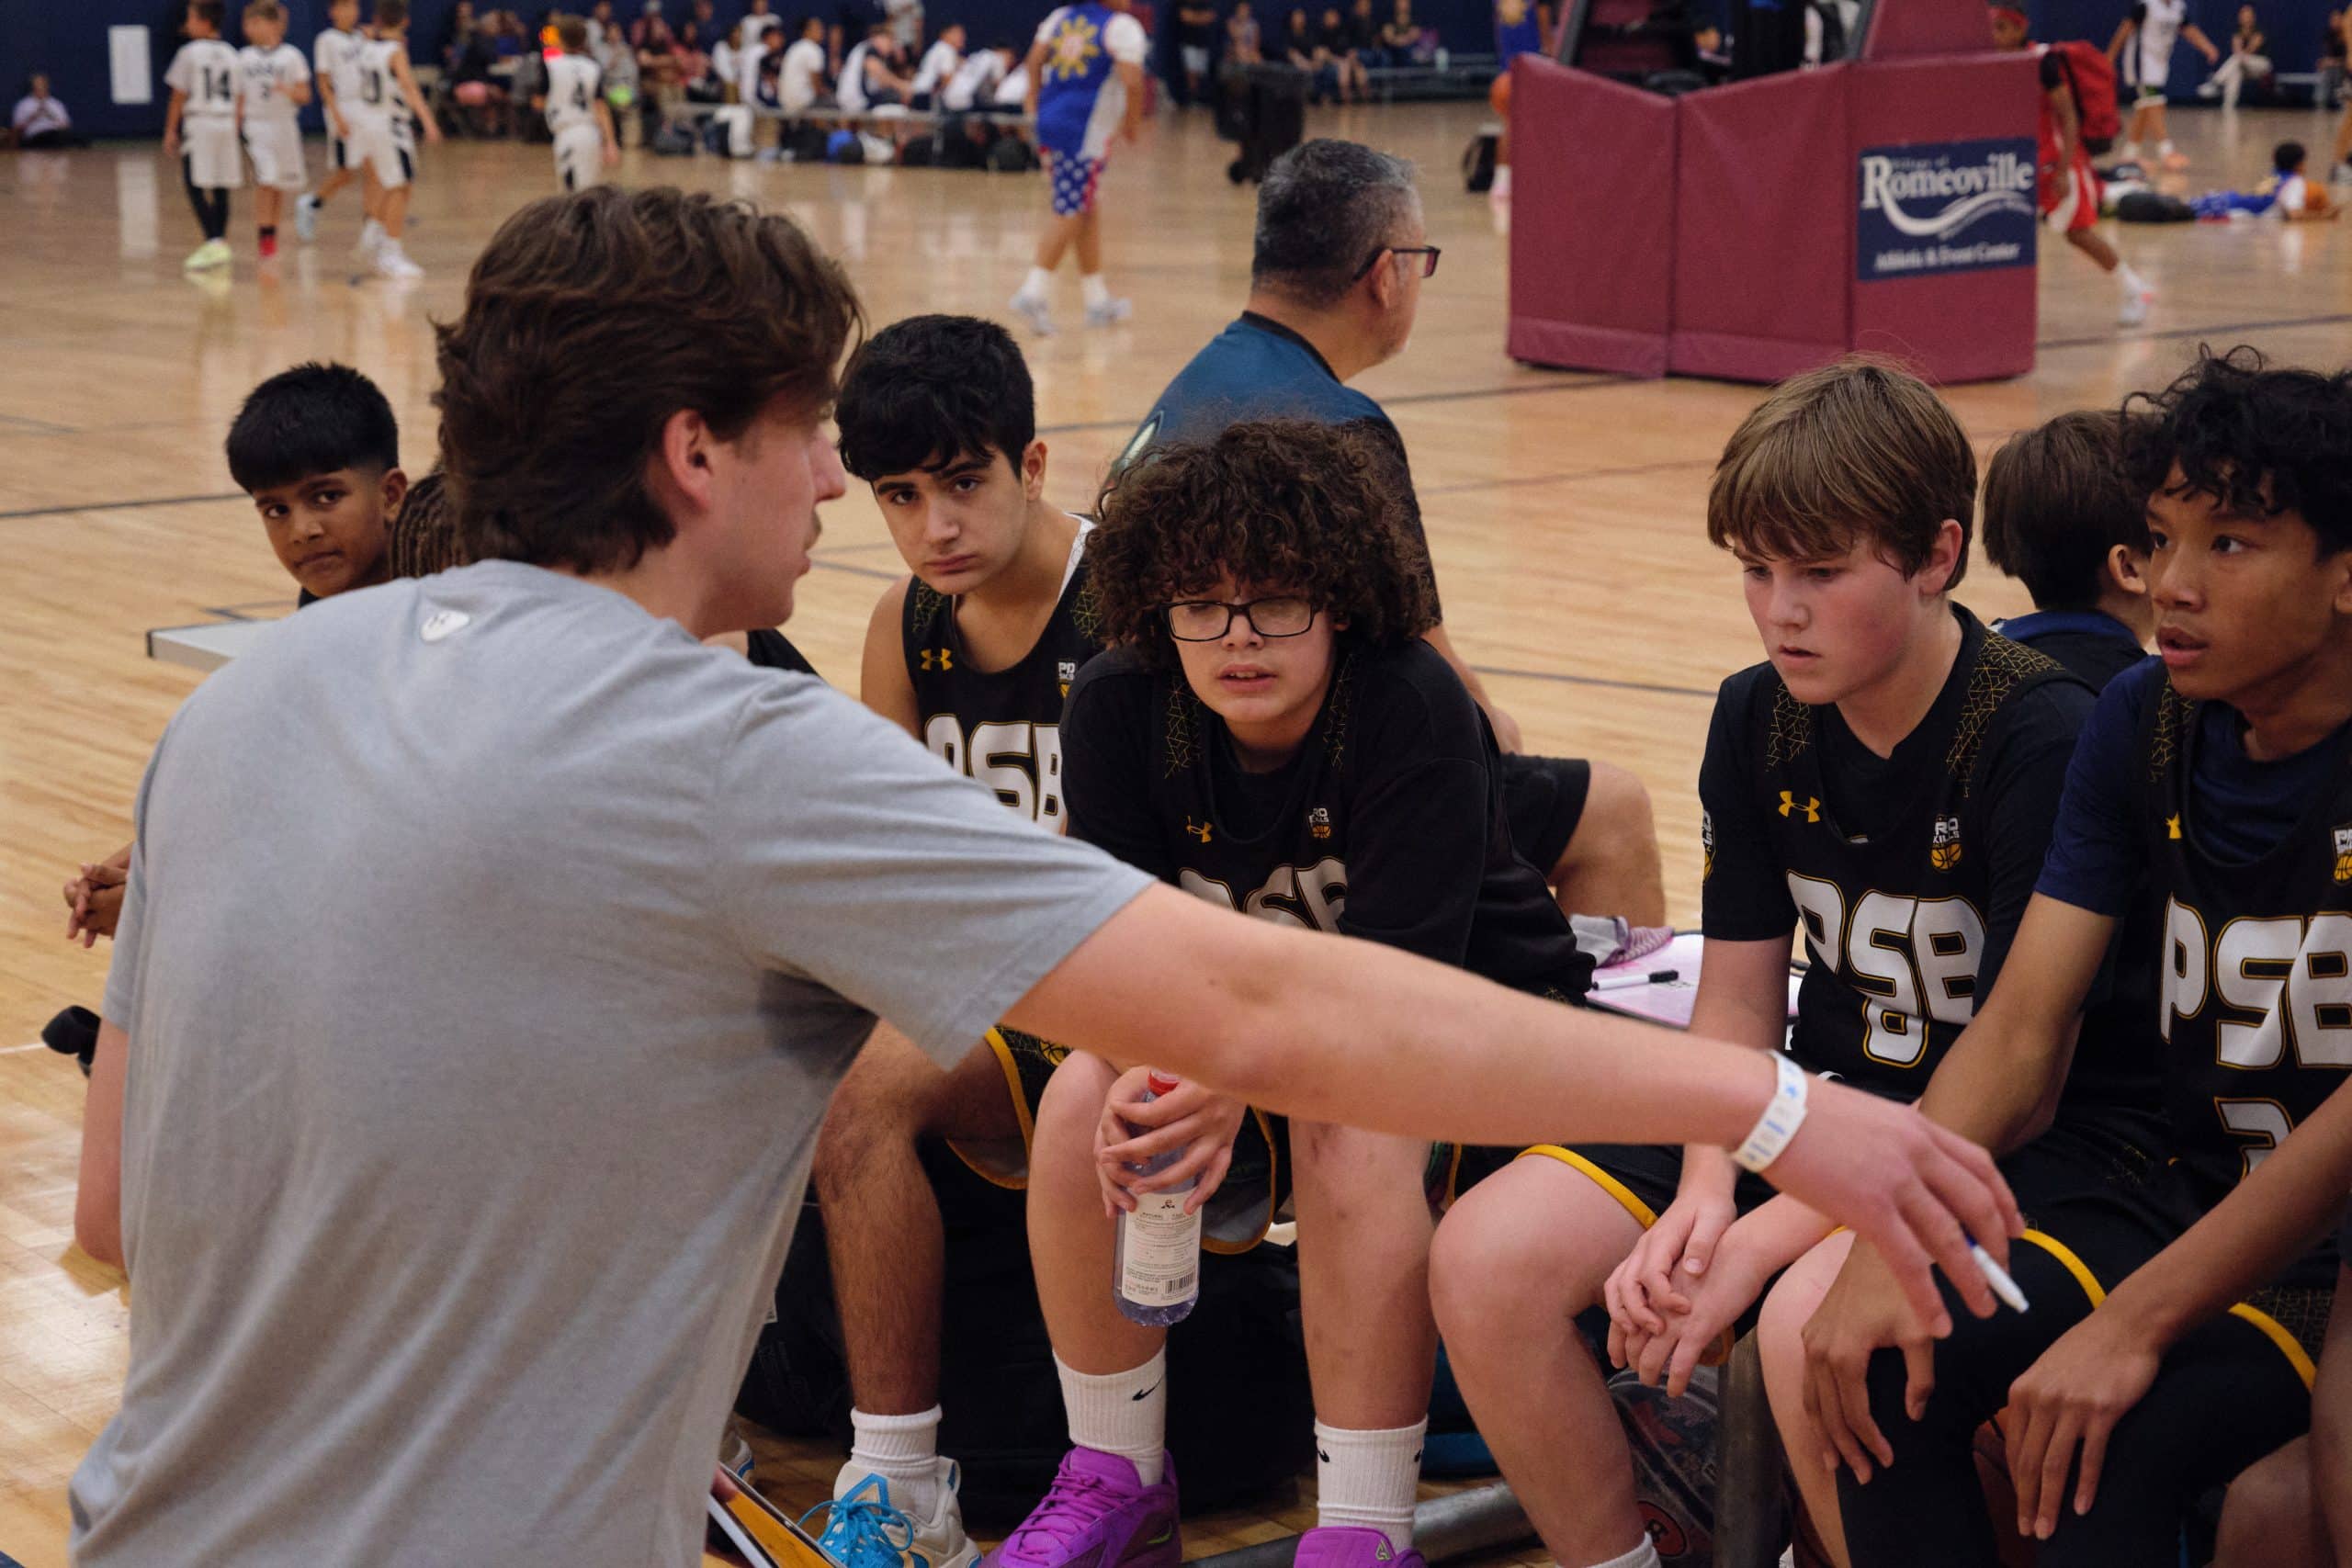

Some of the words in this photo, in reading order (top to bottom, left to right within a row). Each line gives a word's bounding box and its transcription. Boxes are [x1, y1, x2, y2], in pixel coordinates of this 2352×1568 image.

[202, 65, 230, 101] 14
[1860, 152, 2035, 210] Romeoville
[1785, 868, 1987, 1026] PSB
[2160, 890, 2352, 1068] PSB
